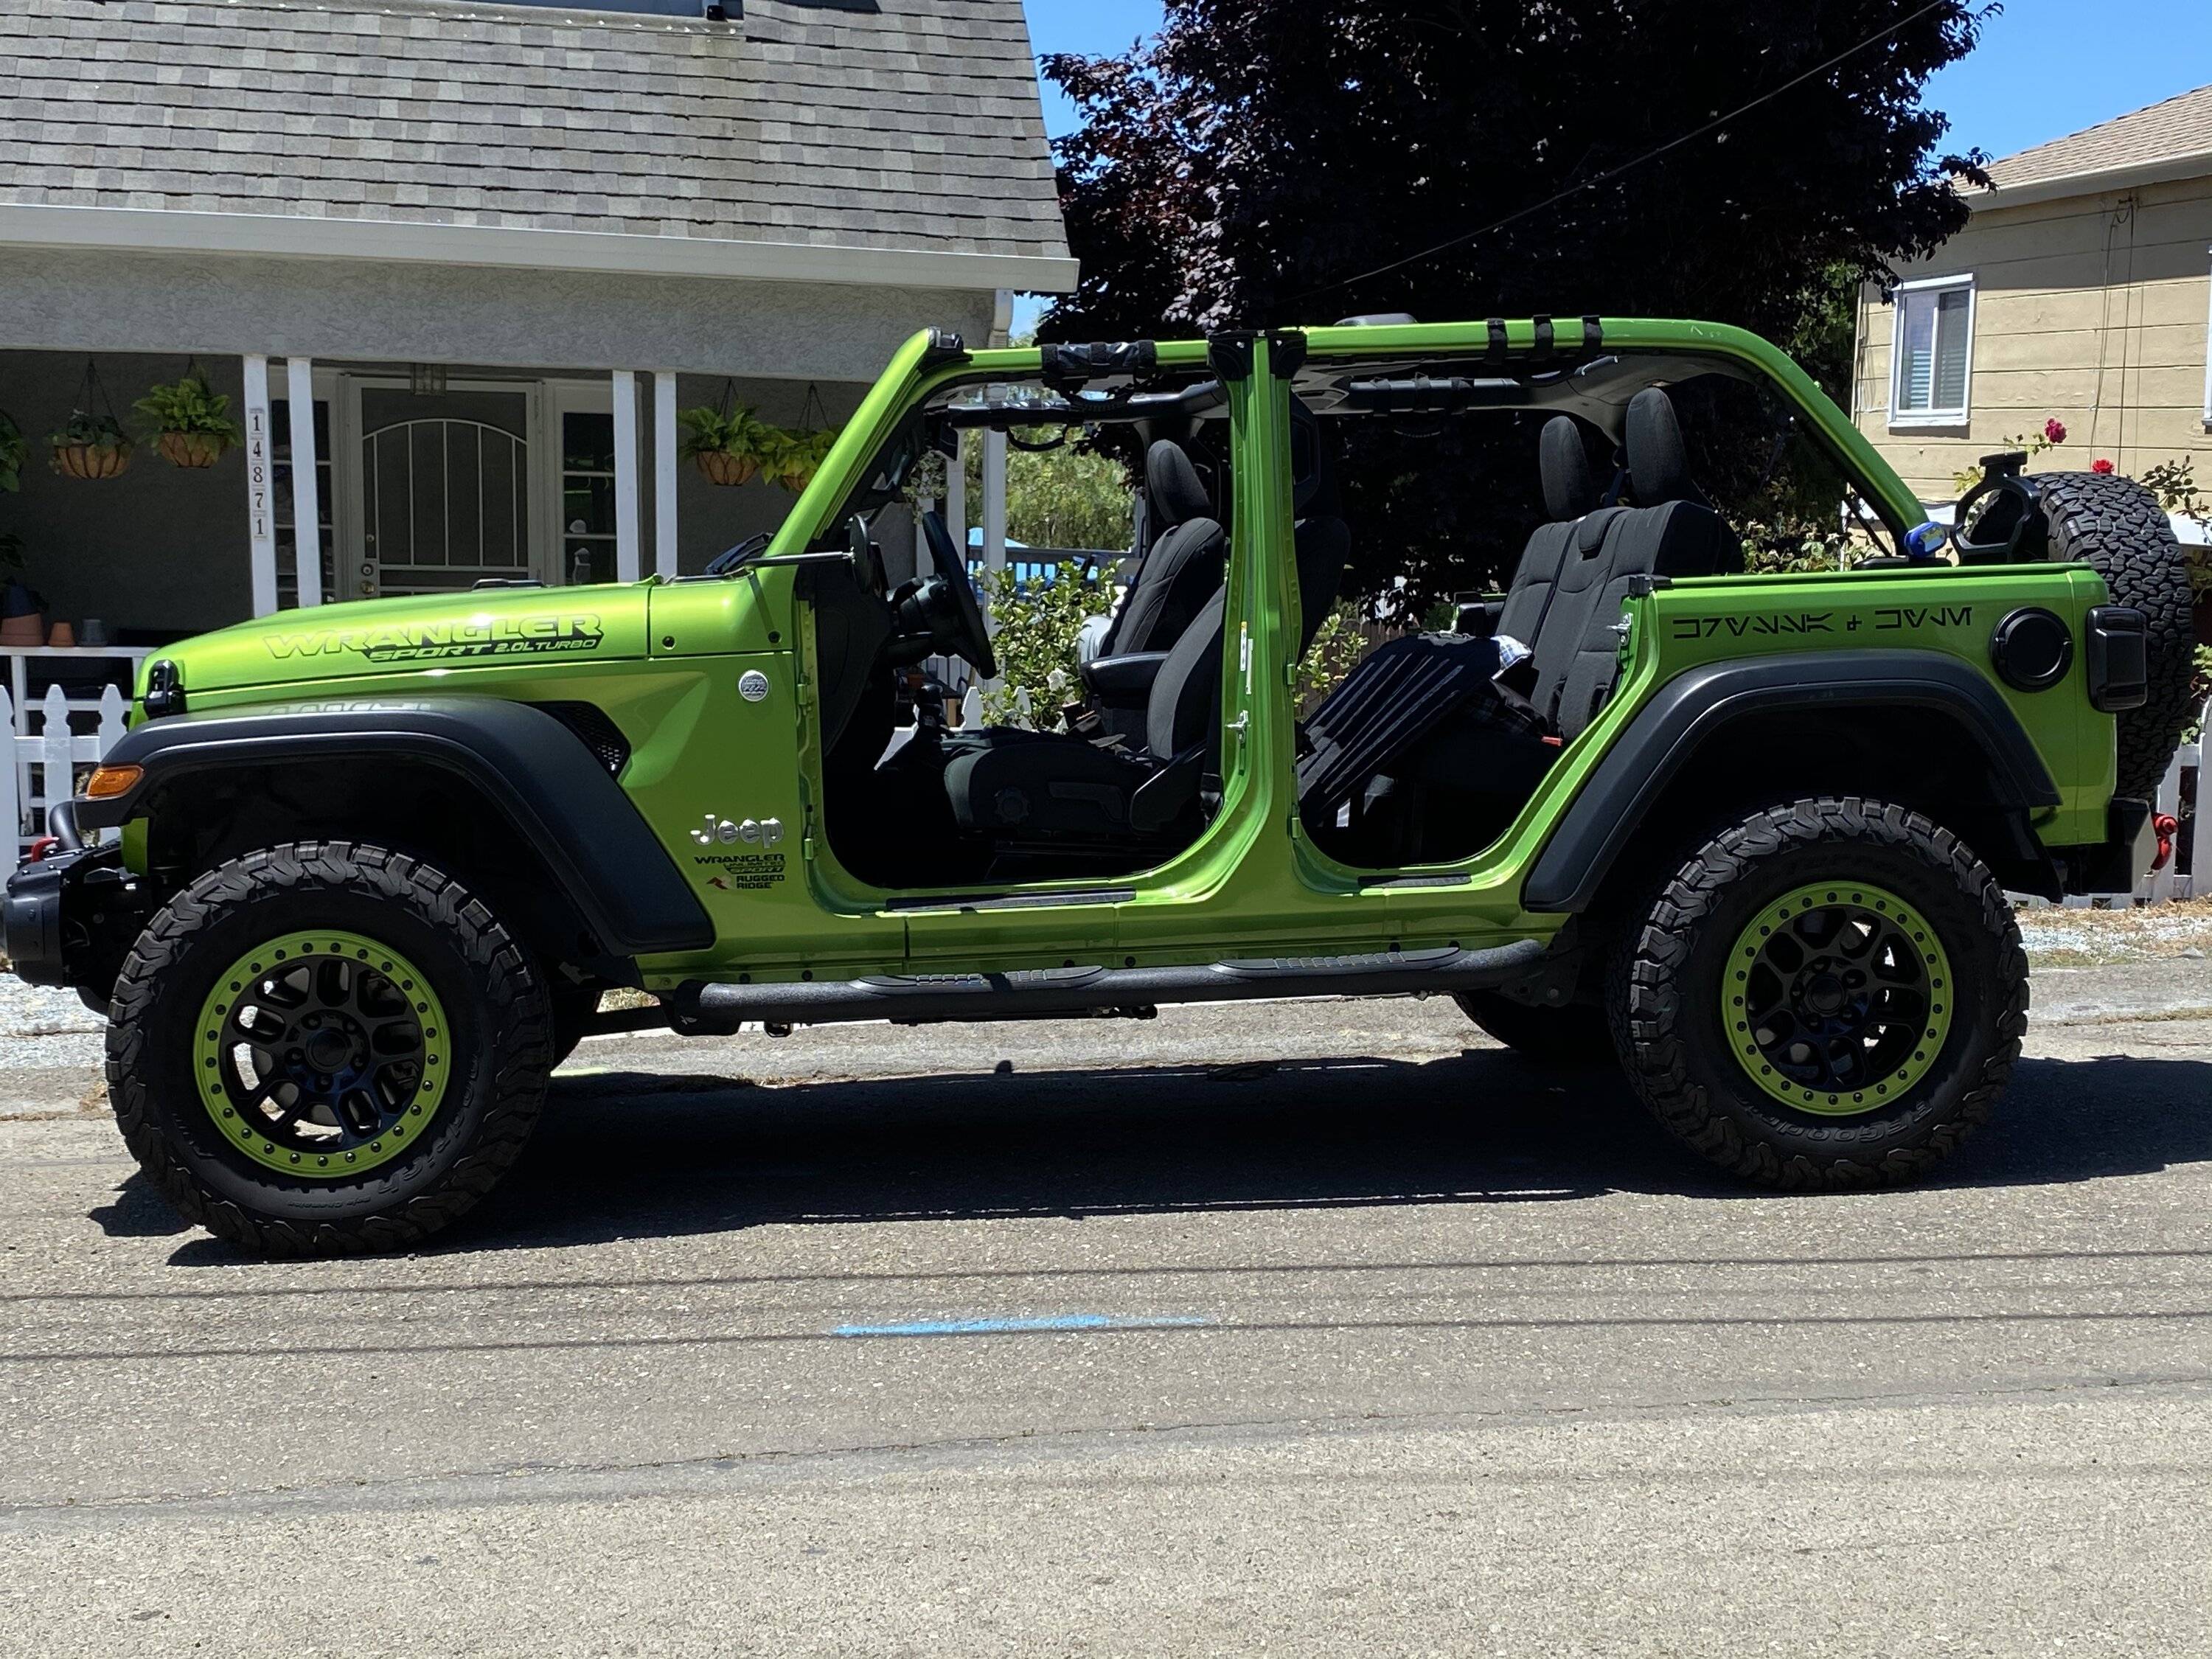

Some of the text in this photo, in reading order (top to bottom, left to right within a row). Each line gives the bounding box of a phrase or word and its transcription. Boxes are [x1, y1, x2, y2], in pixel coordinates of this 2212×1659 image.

[253, 414, 264, 535] 14871
[262, 613, 603, 658] WRANGLER
[369, 639, 597, 662] SPORT 2.0L TURBO
[690, 814, 785, 849] Jeep
[694, 854, 785, 864] WRANGLER
